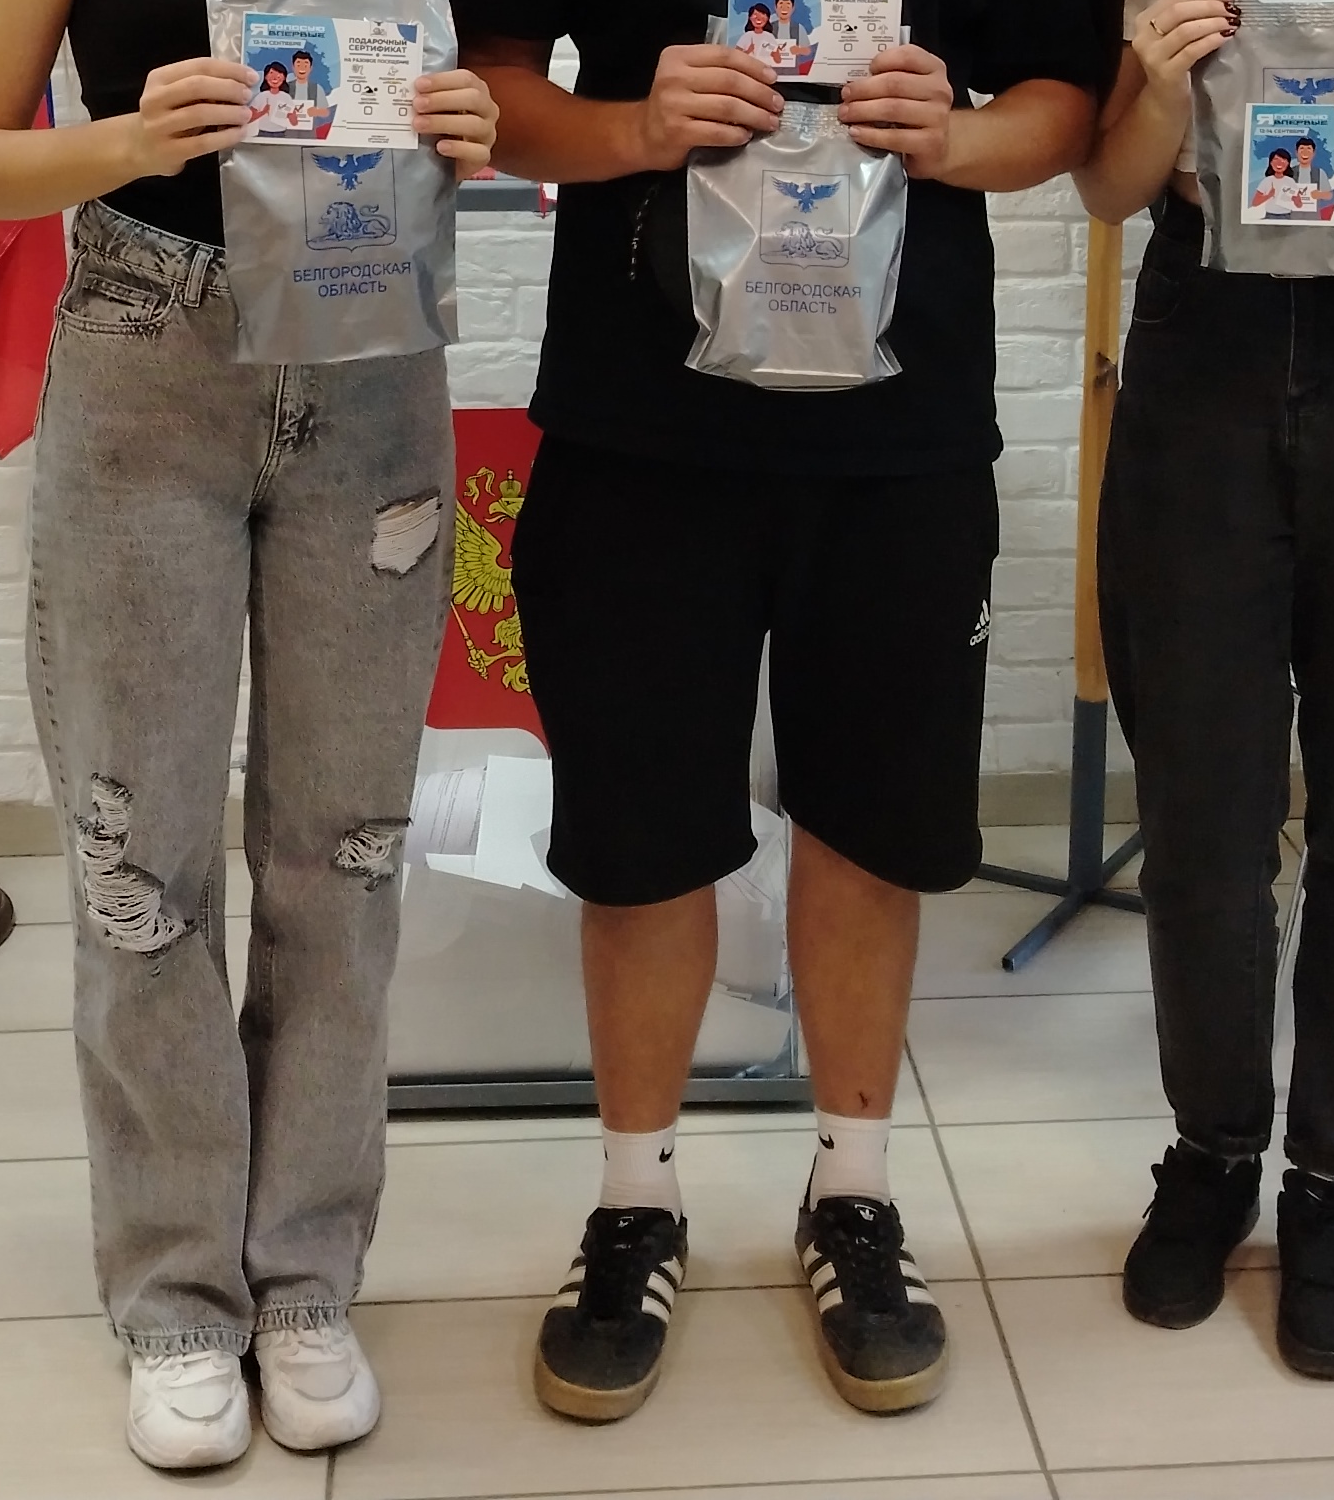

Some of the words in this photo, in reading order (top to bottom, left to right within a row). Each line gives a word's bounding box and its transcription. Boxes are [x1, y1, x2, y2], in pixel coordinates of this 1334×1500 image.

[250, 23, 268, 35] Я
[348, 36, 407, 46] ПОДАРОЧНЫЙ
[348, 45, 407, 53] СЕРТИФИКАТ
[293, 261, 412, 283] БЕЛГОРОДСКАЯ
[317, 281, 387, 298] ОБЛАСТЬ
[745, 280, 863, 299] БЕЛГОРОДСКАЯ
[768, 299, 837, 315] ОБЛАСТЬ
[969, 625, 990, 647] adida
